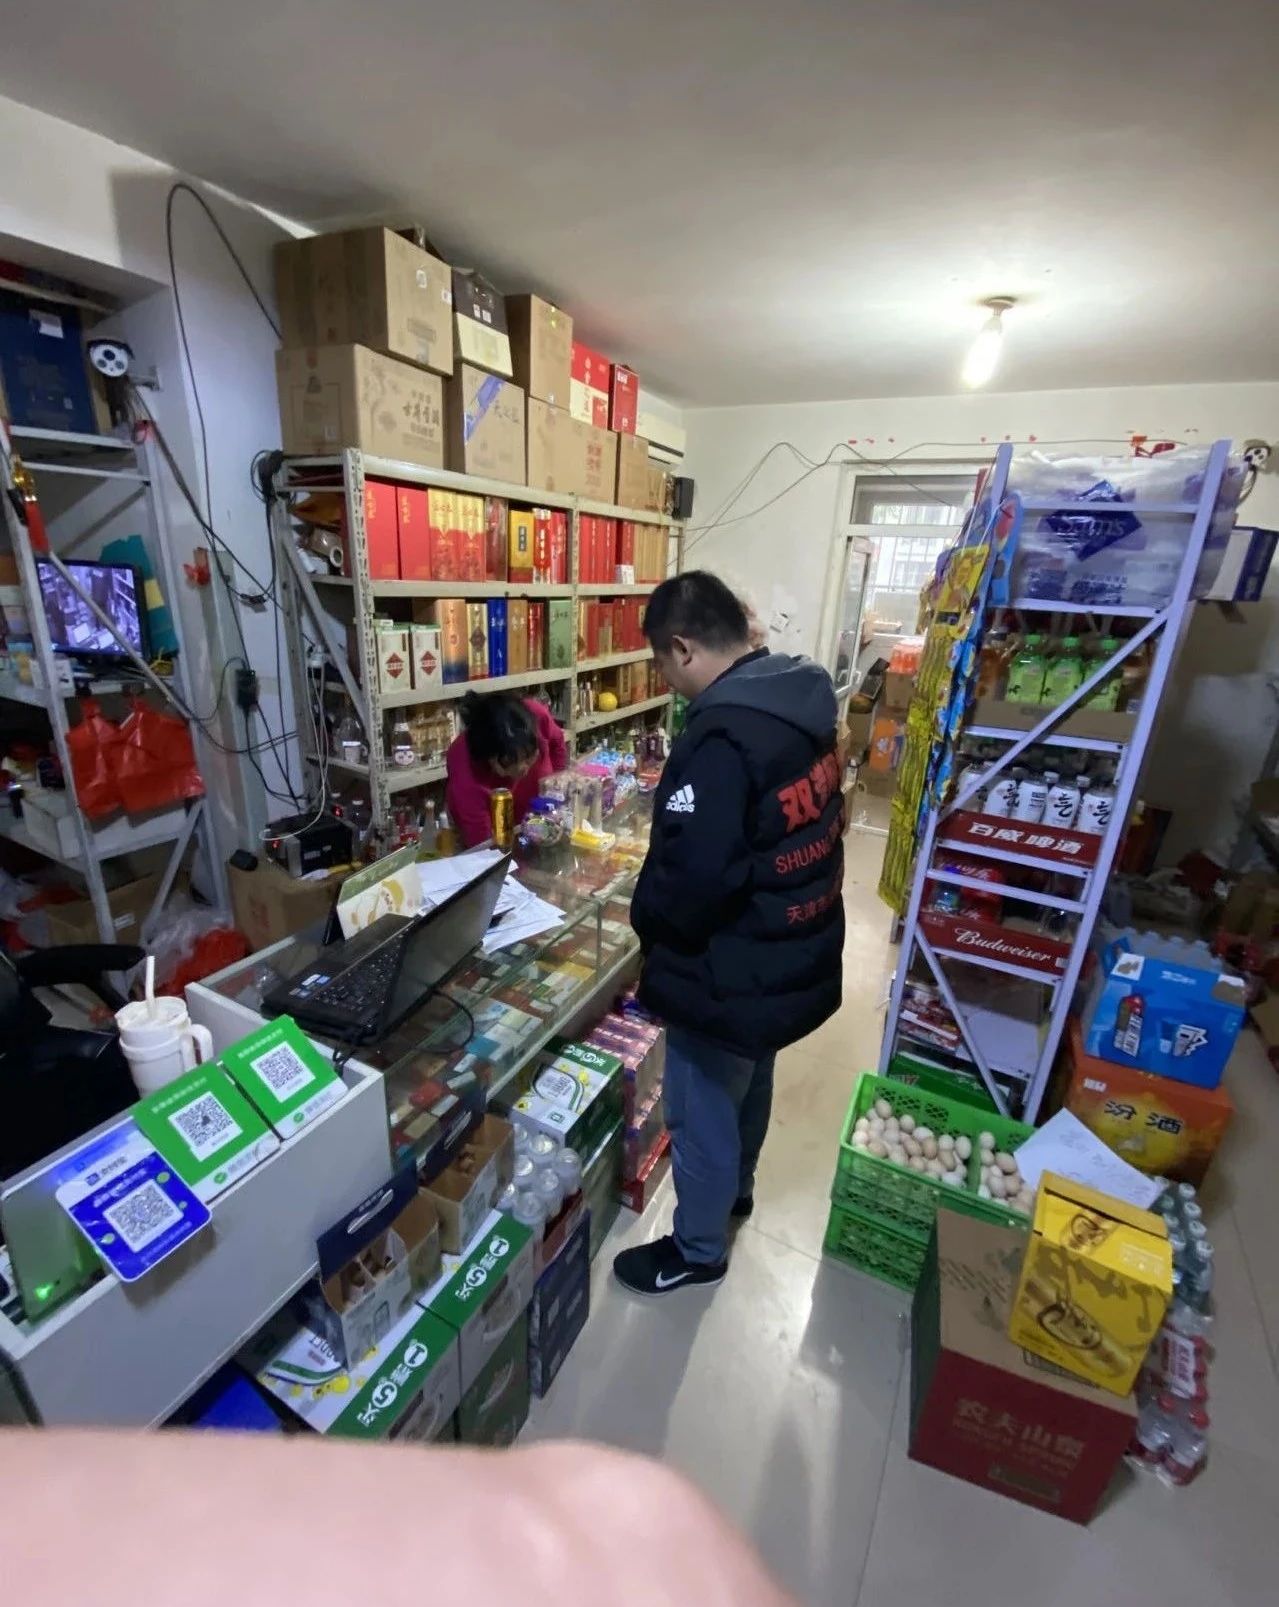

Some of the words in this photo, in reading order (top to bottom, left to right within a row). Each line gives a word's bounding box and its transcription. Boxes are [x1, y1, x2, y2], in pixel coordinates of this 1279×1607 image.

[968, 822, 1082, 855] 百威啤酒
[954, 927, 1051, 961] Budweiser
[1104, 1101, 1184, 1135] 汾酒
